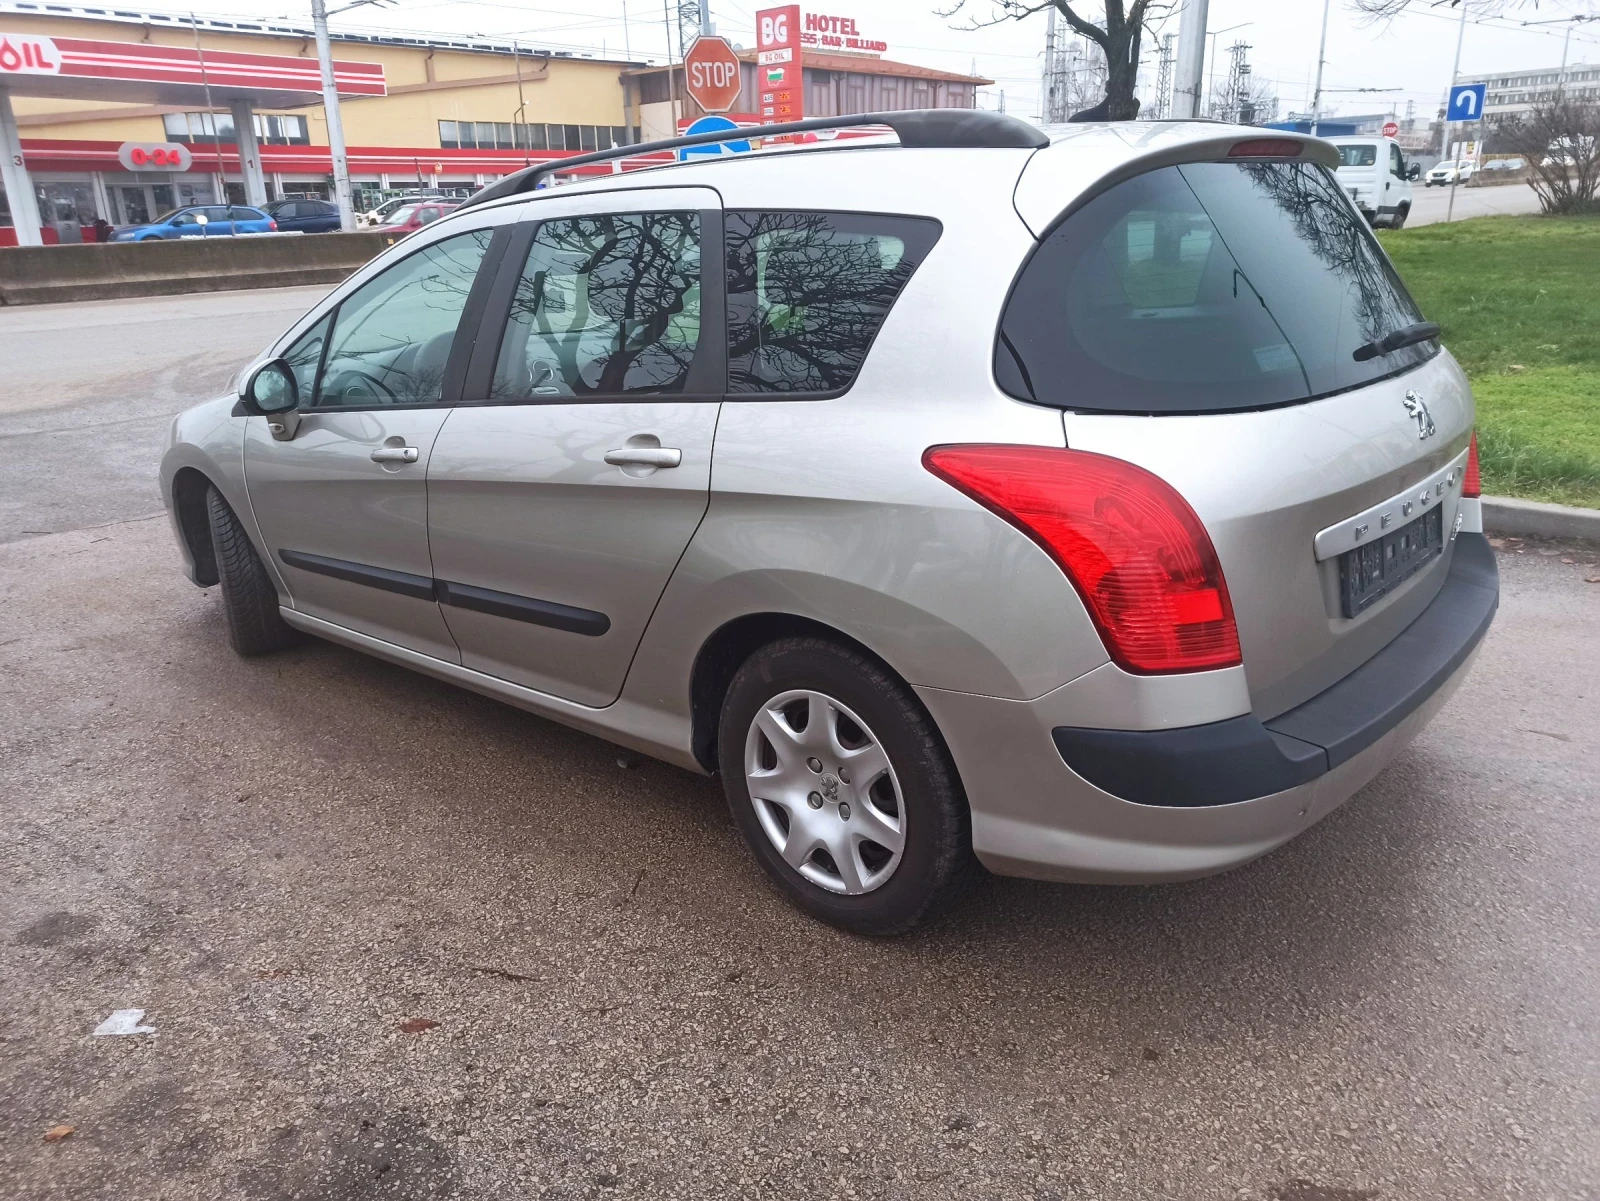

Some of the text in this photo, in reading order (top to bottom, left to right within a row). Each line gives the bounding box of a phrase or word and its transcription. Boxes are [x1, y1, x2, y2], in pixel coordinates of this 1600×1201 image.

[761, 13, 788, 46] BG
[806, 12, 860, 36] HOTEL
[821, 34, 842, 47] BAR
[846, 37, 887, 52] BILLIARD
[0, 37, 53, 71] OIL
[765, 54, 772, 62] BG
[691, 61, 736, 88] STOP
[13, 155, 23, 166] 3
[131, 149, 181, 165] 0-24
[247, 159, 254, 168] 1
[64, 223, 72, 231] 3
[1355, 465, 1463, 541] PEUGEOT
